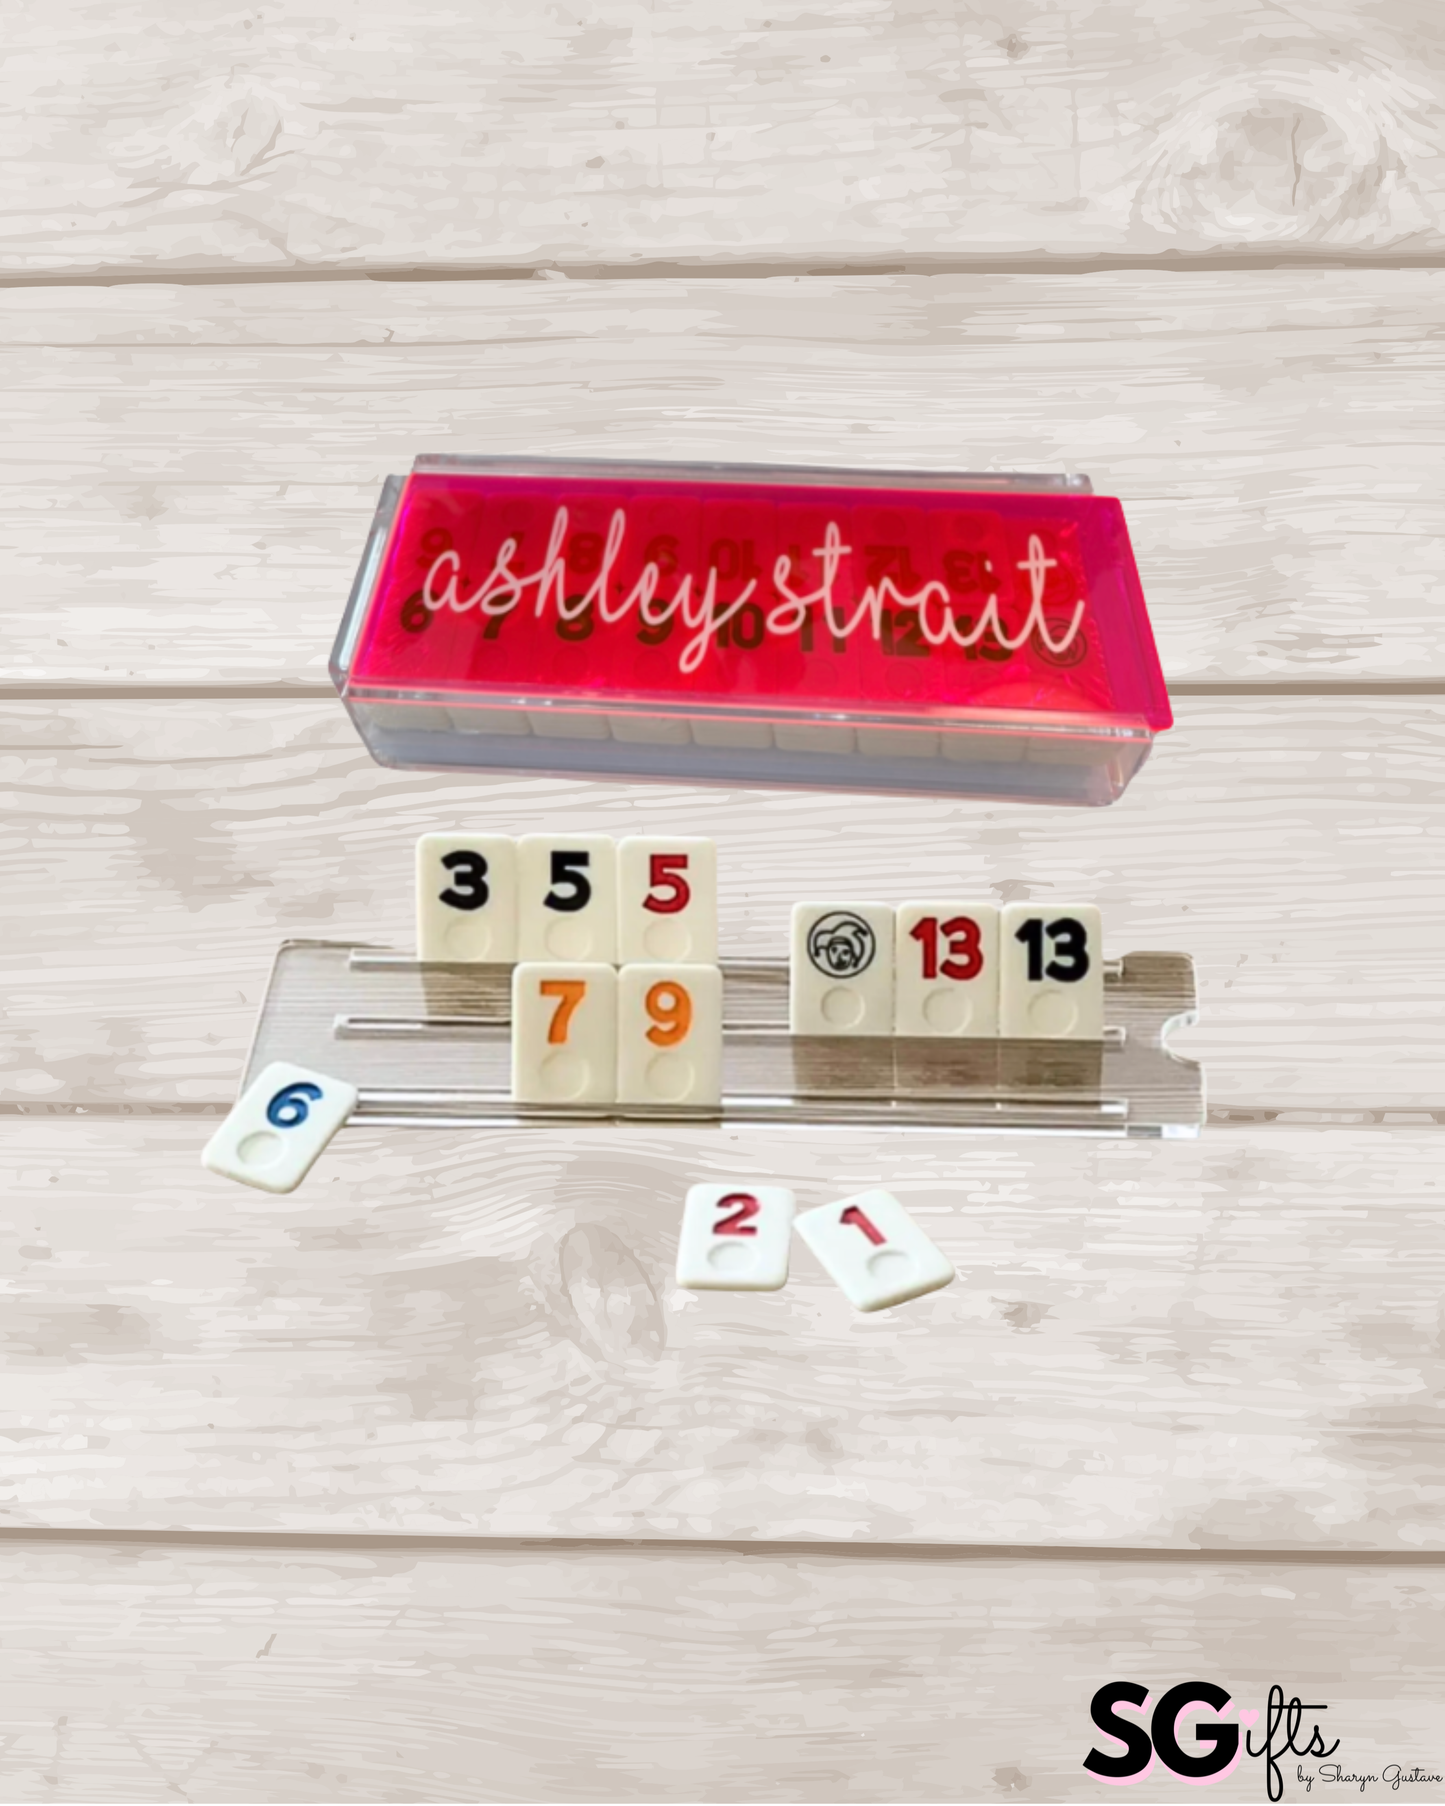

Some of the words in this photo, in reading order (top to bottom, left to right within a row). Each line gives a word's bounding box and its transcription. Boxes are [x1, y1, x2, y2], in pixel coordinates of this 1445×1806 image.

[400, 589, 440, 634] 6
[423, 505, 758, 674] ashley
[766, 521, 1085, 653] strait
[556, 594, 595, 642] 8
[636, 598, 675, 646] 9
[713, 602, 765, 649] 10
[438, 850, 489, 911] 3
[543, 851, 592, 912] 5
[642, 854, 691, 914] 5
[909, 916, 984, 981] 13
[1014, 917, 1090, 983] 13
[540, 980, 586, 1044] 7
[645, 980, 693, 1046] 9
[266, 1082, 323, 1128] 6
[712, 1192, 760, 1236] 2
[839, 1205, 886, 1246] 1
